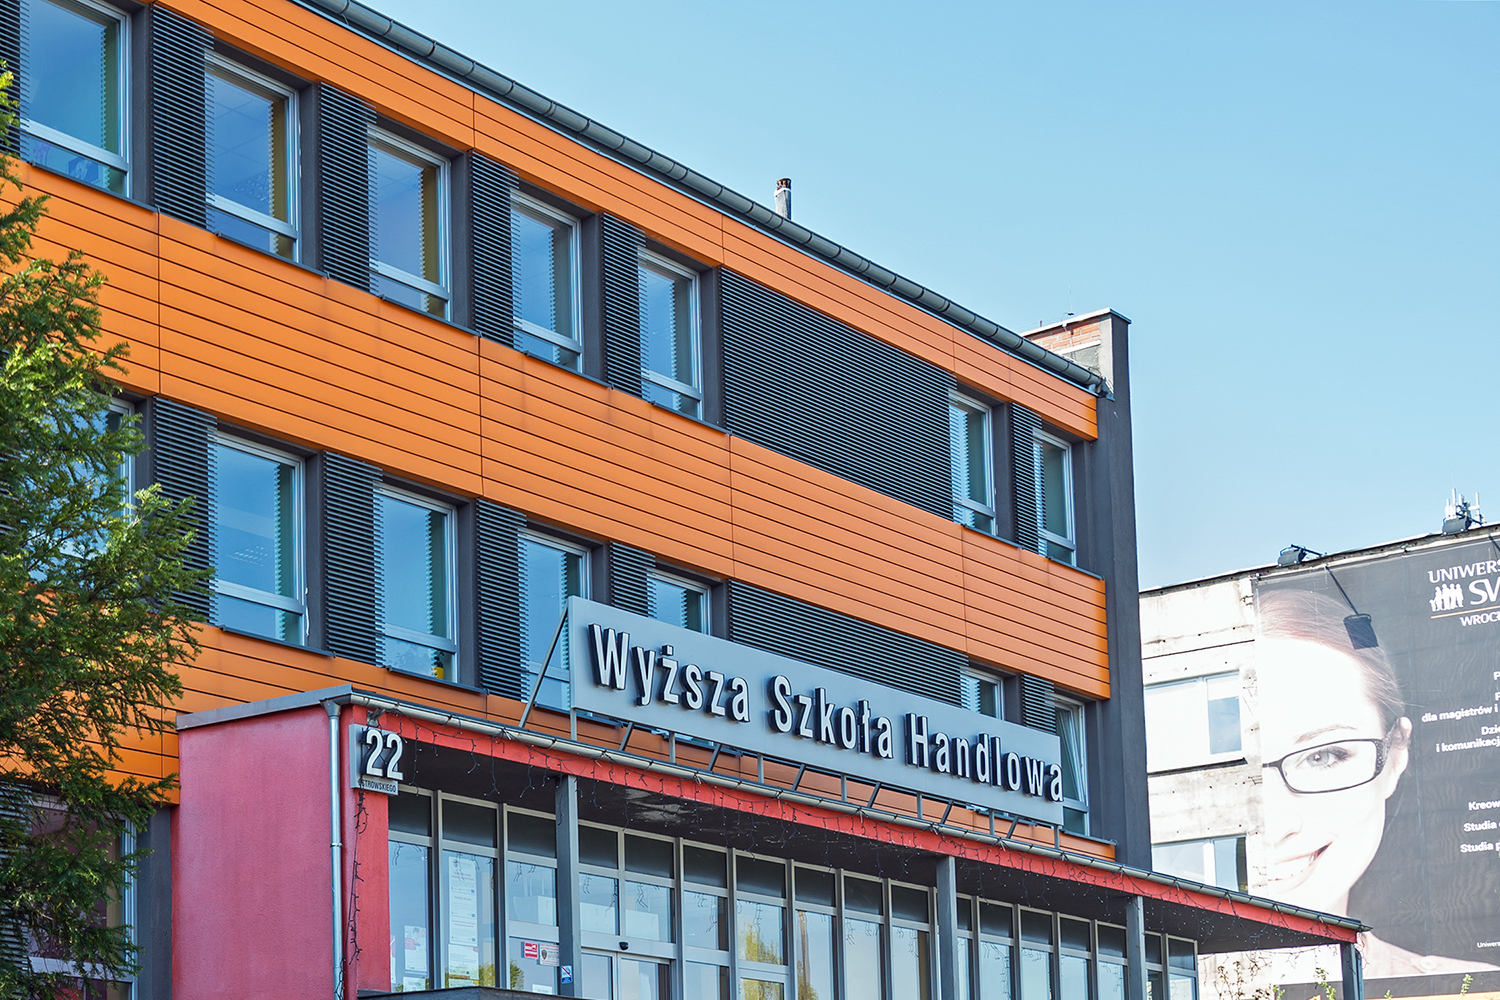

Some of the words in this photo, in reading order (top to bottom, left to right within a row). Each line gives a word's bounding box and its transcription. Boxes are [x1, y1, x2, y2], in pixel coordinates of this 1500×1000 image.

[588, 624, 750, 723] Wyższa
[768, 675, 893, 758] Szkoła
[905, 712, 1063, 802] Handlowa
[1421, 712, 1438, 723] dla
[1439, 705, 1493, 720] magistrów
[362, 729, 403, 780] 22
[1463, 820, 1497, 832] Studia
[1460, 841, 1494, 853] Studia
